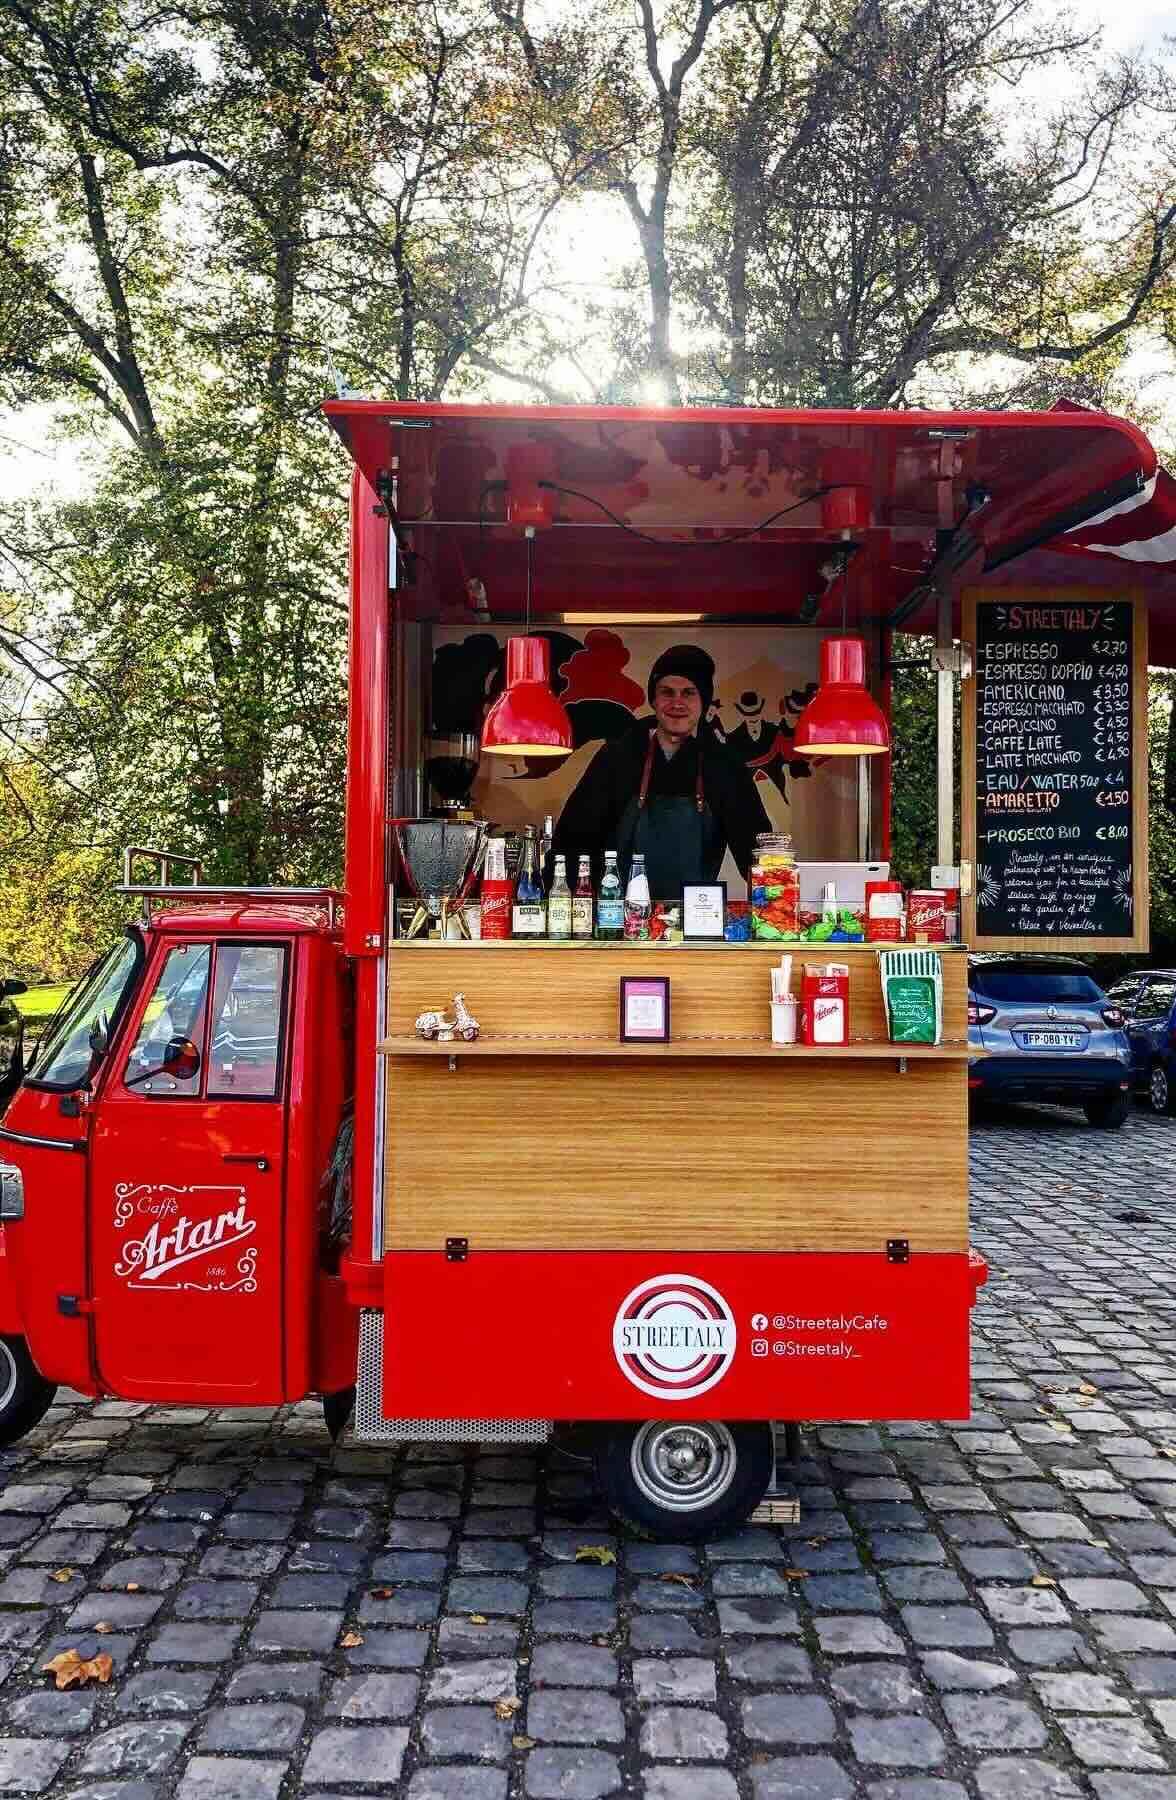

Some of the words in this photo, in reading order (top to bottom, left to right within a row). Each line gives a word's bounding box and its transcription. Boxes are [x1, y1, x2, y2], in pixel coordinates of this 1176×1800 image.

[1008, 607, 1101, 631] STREETALY
[1051, 661, 1093, 680] DOPPIO
[984, 719, 1056, 734] CAPPUCCINO
[1028, 735, 1064, 751] LATTE
[985, 753, 1024, 768] LATTE
[1026, 751, 1081, 766] MACCHIATO
[985, 791, 1061, 808] AMARETTO
[986, 826, 1055, 843] PROSECCO
[1058, 825, 1081, 839] BIO
[114, 1195, 257, 1280] Artari
[772, 1314, 888, 1334] @StreetalyCafe
[622, 1326, 727, 1348] STREETALY
[772, 1341, 862, 1358] @Streetaly_
